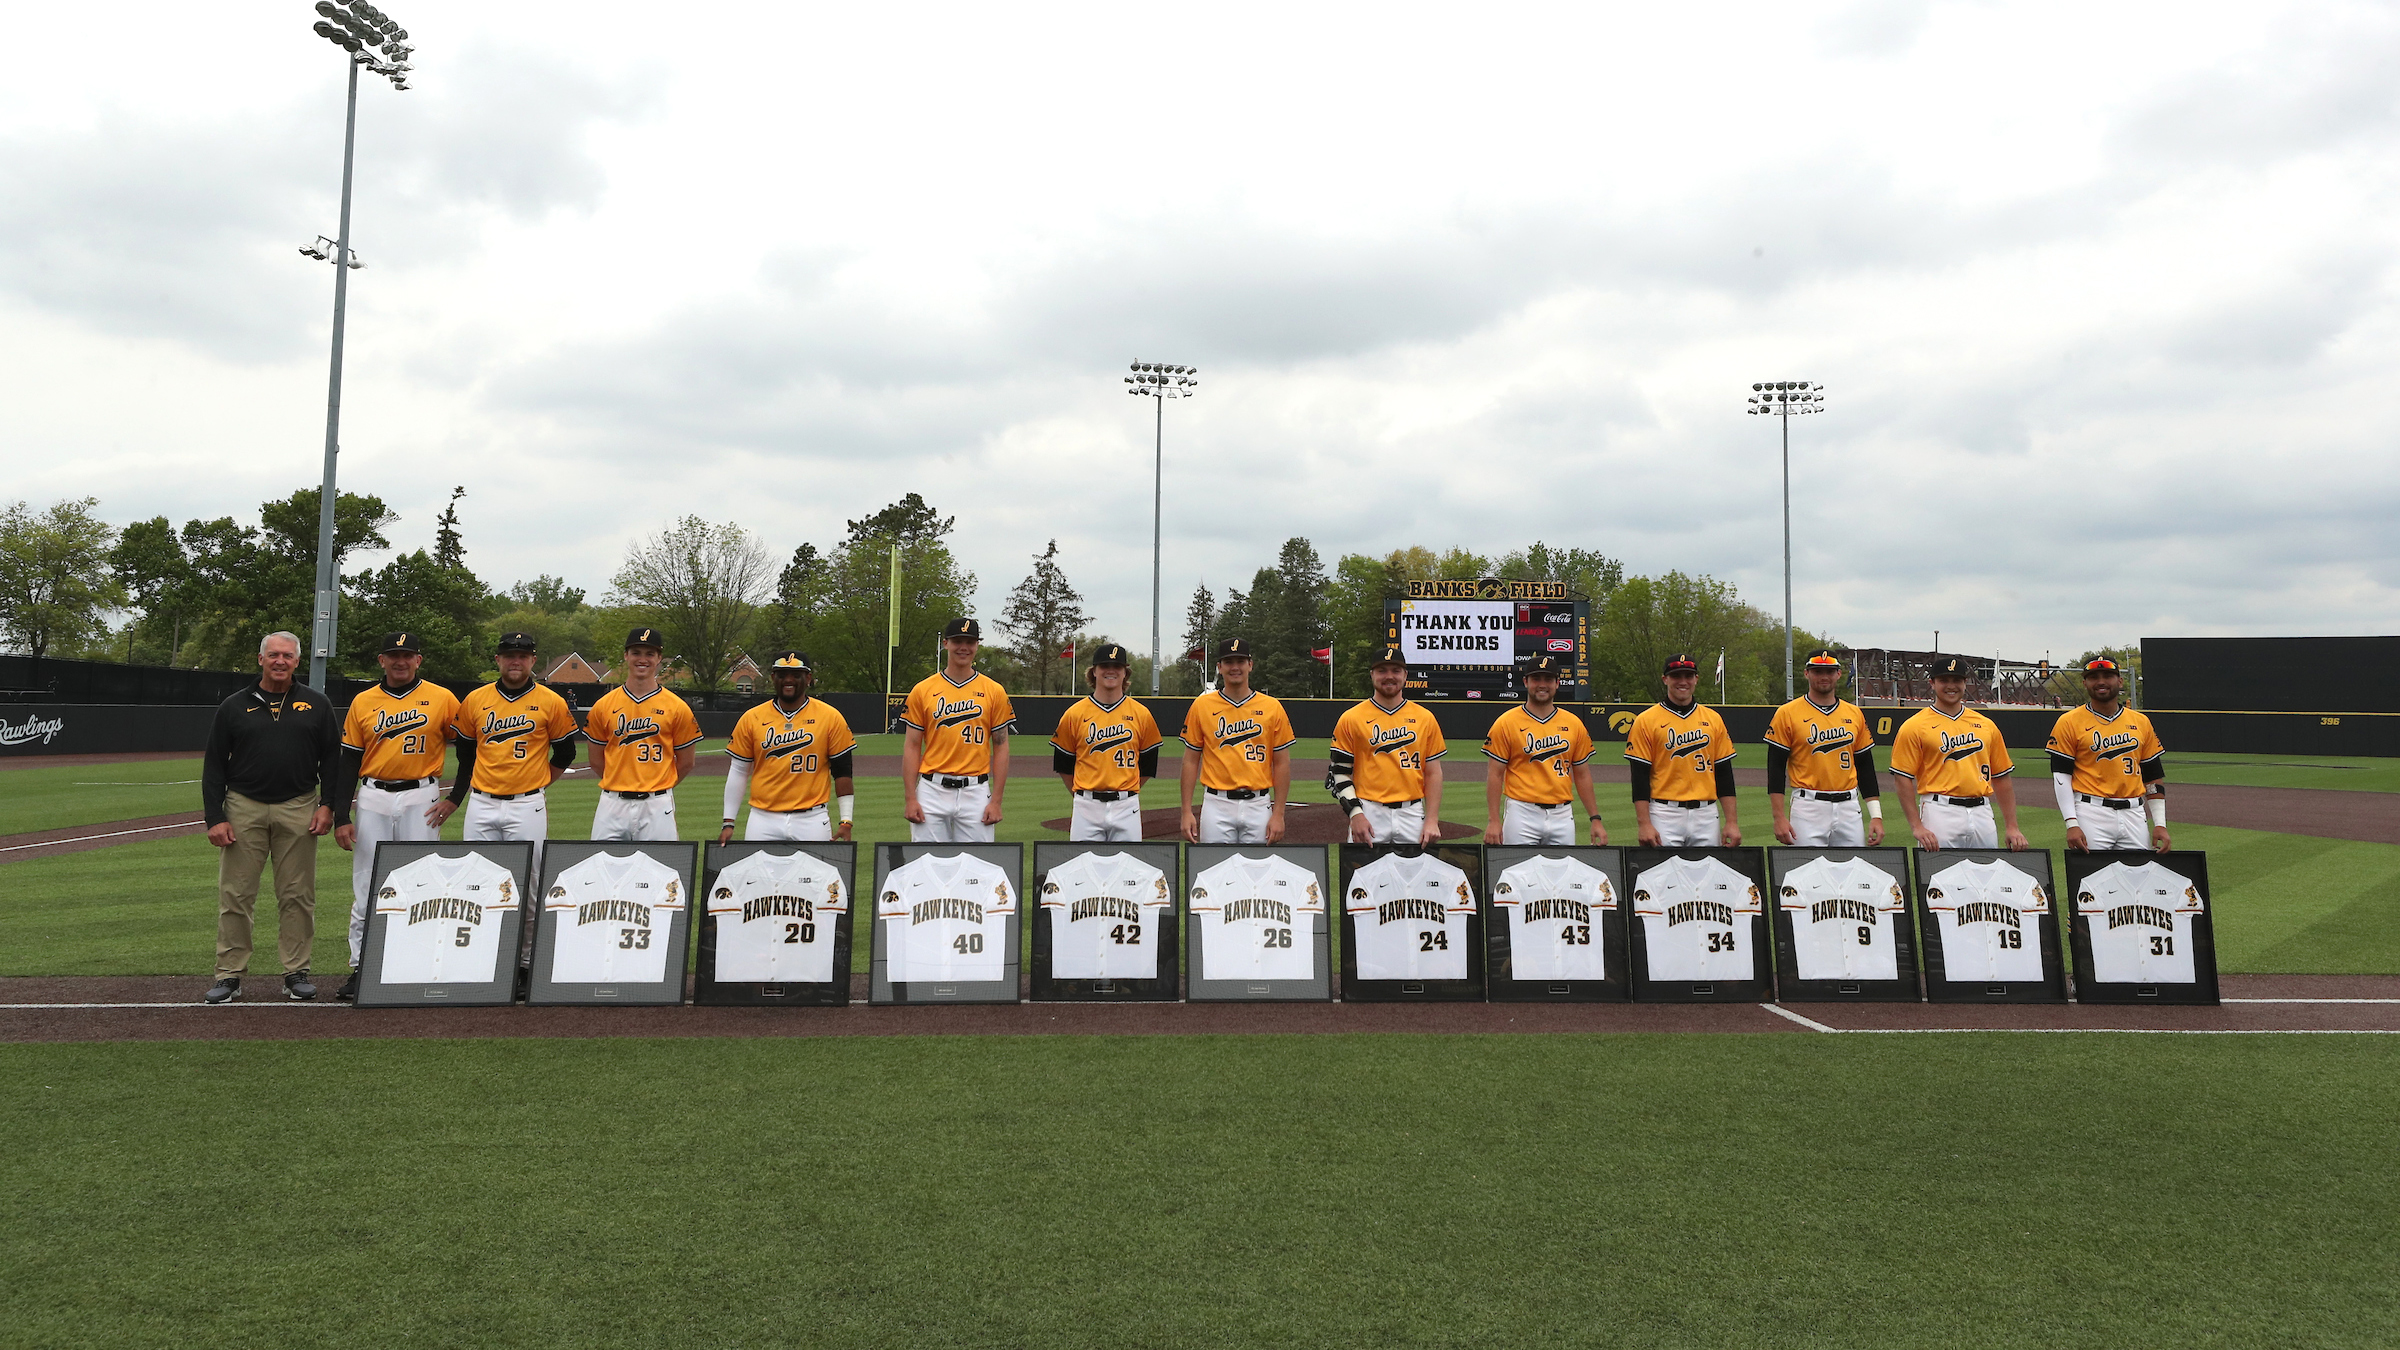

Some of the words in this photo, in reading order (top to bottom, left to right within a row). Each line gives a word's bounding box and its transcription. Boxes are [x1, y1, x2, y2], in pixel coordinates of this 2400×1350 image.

[1409, 580, 1476, 598] BANKS
[1509, 582, 1567, 599] FIELD
[1387, 613, 1400, 649] IOW
[1402, 614, 1471, 630] THANK
[1478, 615, 1514, 630] YOU
[1516, 628, 1545, 636] LENNOX
[1417, 635, 1499, 650] SENIORS
[1578, 617, 1586, 662] SHARP
[933, 696, 974, 720] Iowa
[0, 714, 64, 745] Rawlings
[373, 708, 418, 733] Iowa
[482, 711, 526, 735] Iowa
[614, 713, 652, 737] Iowa
[1215, 716, 1254, 739] Iowa
[2320, 717, 2340, 726] 396
[762, 726, 804, 750] Iowa
[961, 725, 984, 745] 40
[1085, 722, 1124, 744] Iowa
[1369, 724, 1408, 746] Iowa
[1523, 732, 1561, 755] Iowa
[1665, 728, 1702, 750] Iowa
[1806, 723, 1846, 745] Iowa
[1939, 730, 1974, 754] Iowa
[2089, 730, 2130, 753] Iowa
[402, 735, 426, 755] 21
[513, 740, 528, 759] 5
[637, 743, 663, 763] 33
[790, 754, 818, 773] 20
[1114, 749, 1136, 769] 42
[1400, 751, 1421, 770] 24
[1840, 751, 1851, 770] 9
[1976, 763, 1990, 782] 9
[408, 898, 482, 926] HAWKEYES
[578, 899, 650, 928] HAWKEYES
[743, 895, 813, 924] HAWKEYES
[912, 898, 983, 926] HAWKEYES
[1071, 897, 1139, 923] HAWKEYES
[1224, 898, 1291, 925] HAWKEYES
[1379, 899, 1445, 925] HAWKEYES
[1525, 899, 1589, 924] HAWKEYES
[1668, 901, 1733, 928] HAWKEYES
[1812, 899, 1876, 925] HAWKEYES
[1957, 902, 2020, 929] HAWKEYES
[2108, 905, 2173, 932] HAWKEYES
[455, 927, 471, 947] 5
[619, 929, 652, 950] 33
[784, 923, 815, 944] 20
[953, 933, 984, 954] 40
[1110, 924, 1141, 945] 42
[1264, 928, 1292, 948] 26
[1419, 931, 1448, 951] 24
[1561, 925, 1590, 945] 43
[1708, 932, 1734, 953] 34
[1858, 926, 1871, 946] 9
[1998, 930, 2022, 949] 19
[2150, 936, 2174, 956] 31
